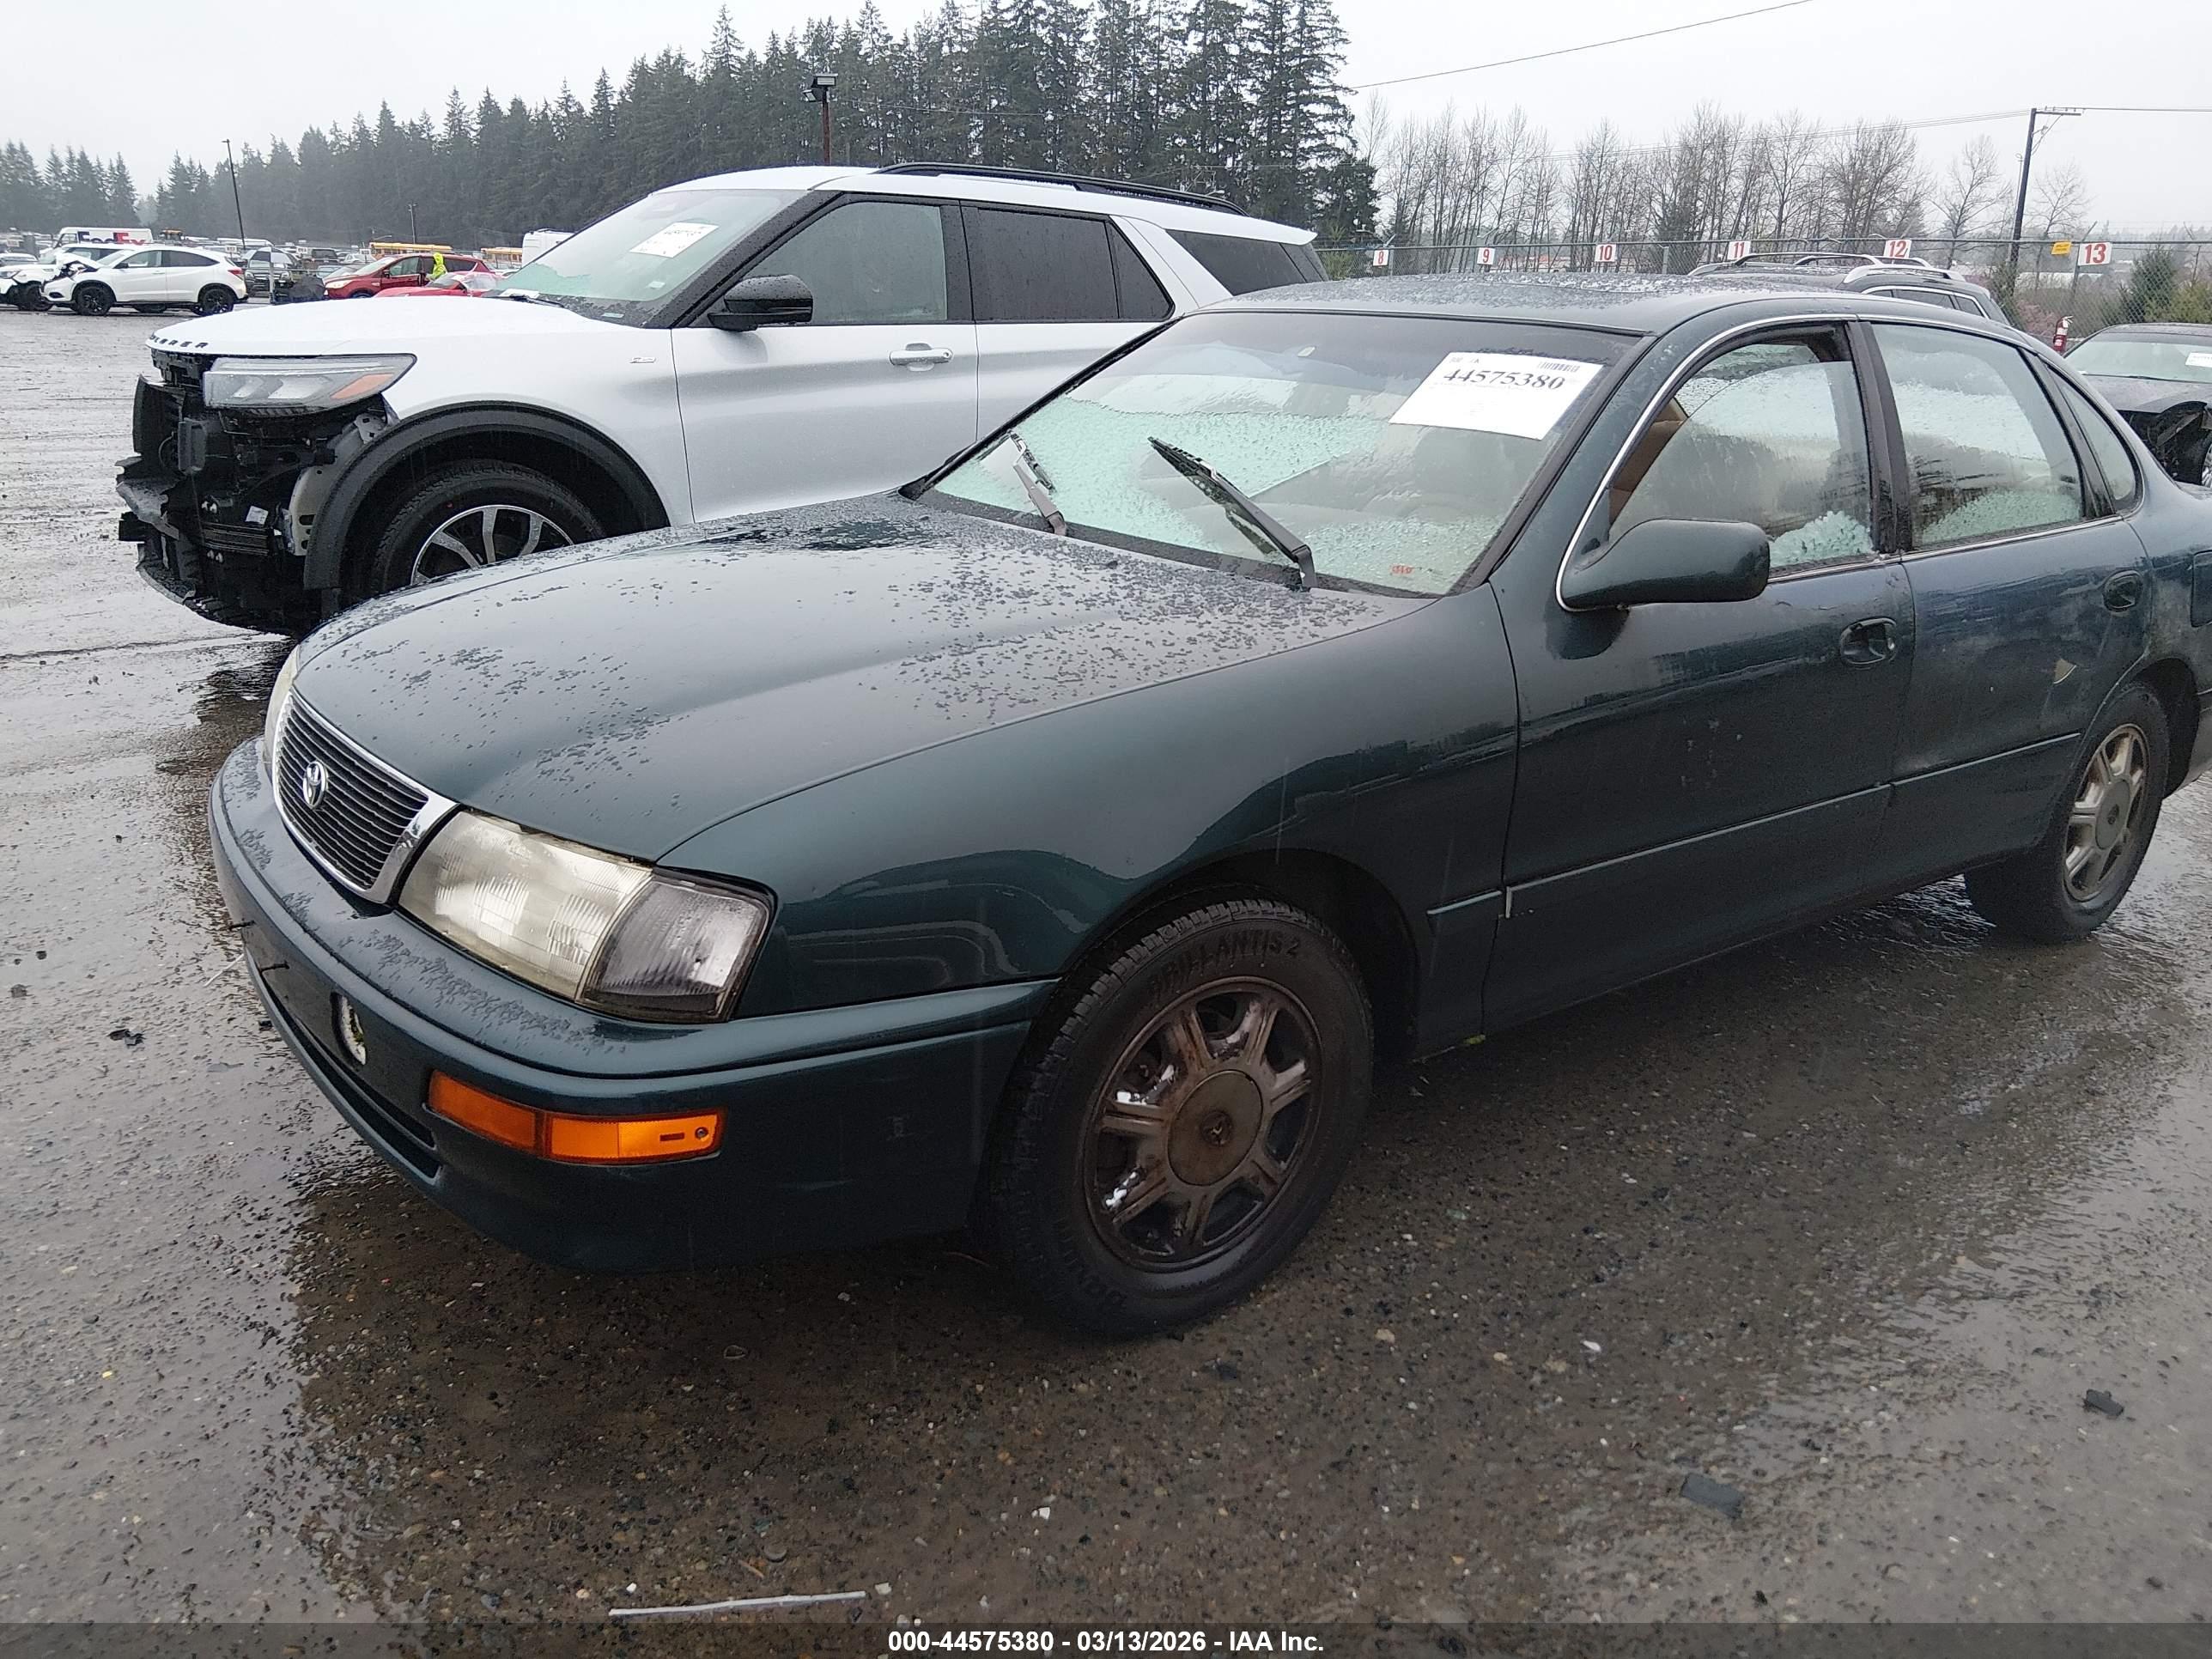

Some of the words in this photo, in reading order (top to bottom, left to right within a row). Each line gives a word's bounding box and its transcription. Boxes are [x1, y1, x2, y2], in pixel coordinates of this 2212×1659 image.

[1377, 251, 1384, 264] 8
[1482, 248, 1490, 264] 9
[1599, 245, 1613, 261] 10
[1733, 241, 1745, 258] 11
[1888, 240, 1909, 258] 12
[2085, 243, 2106, 264] 13
[1443, 368, 1565, 390] 44575380
